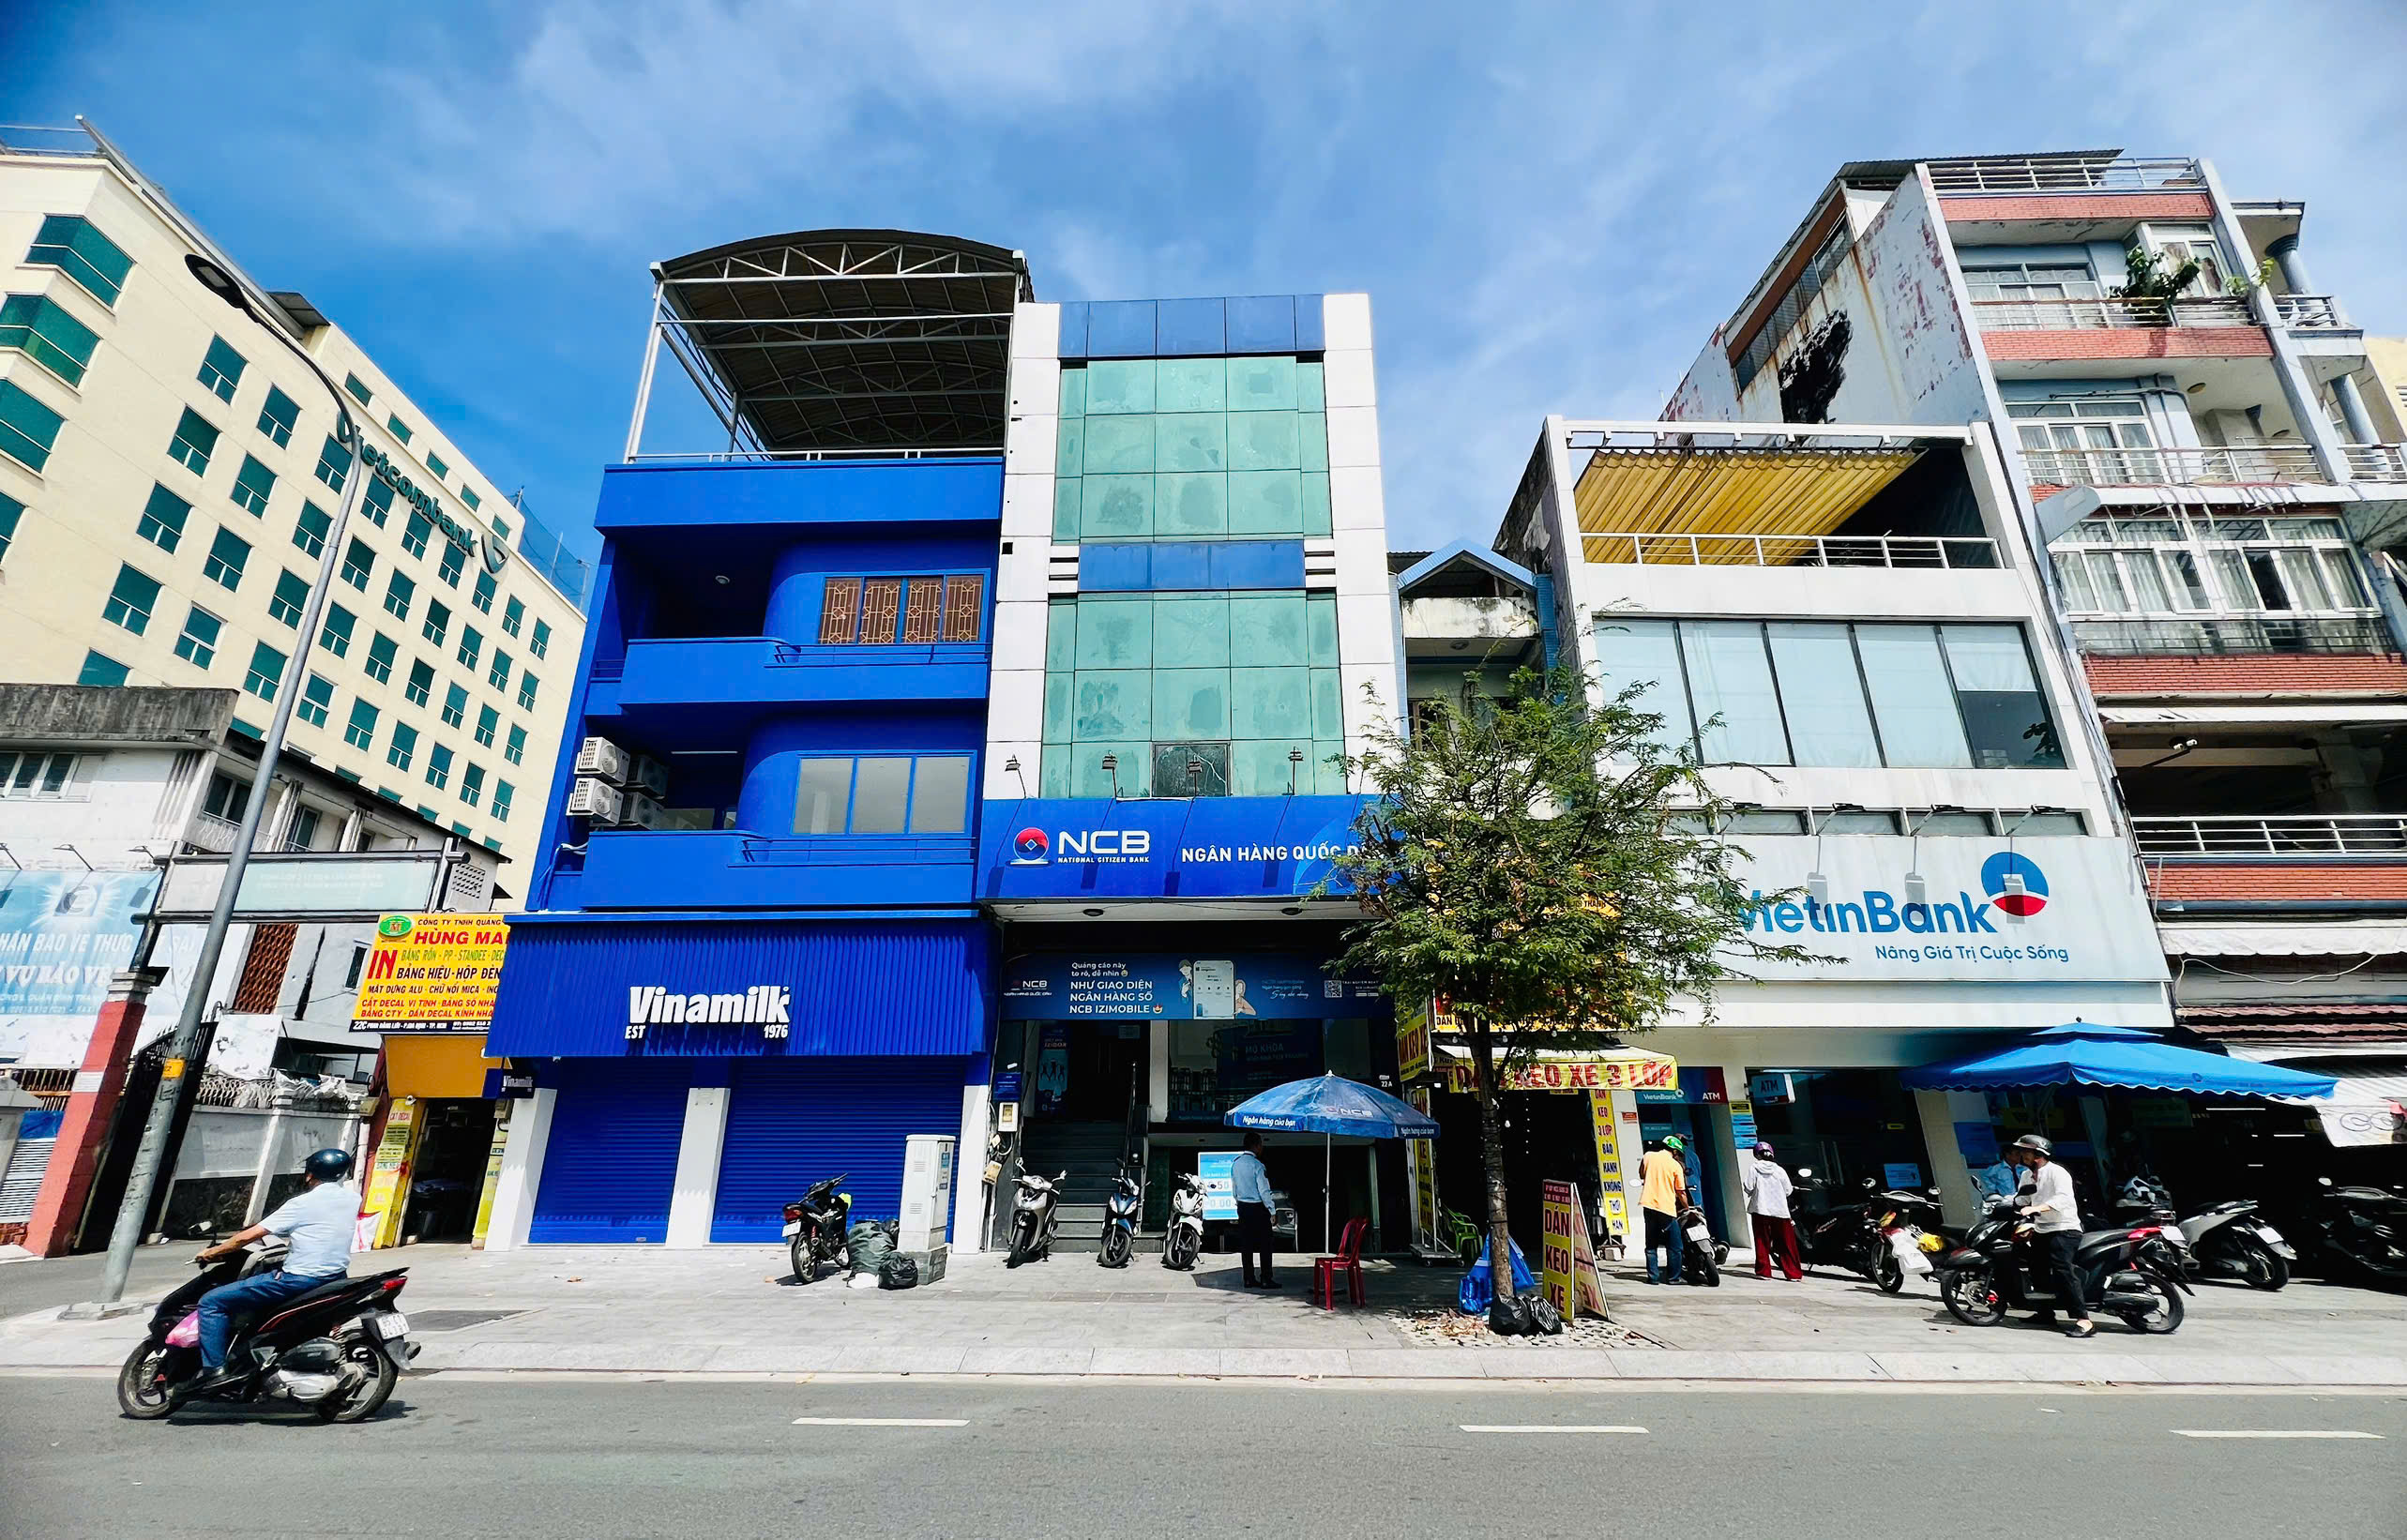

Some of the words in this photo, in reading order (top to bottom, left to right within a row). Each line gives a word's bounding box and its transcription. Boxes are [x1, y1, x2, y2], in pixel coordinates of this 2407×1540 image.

[1058, 830, 1151, 854] NCB
[1182, 844, 1232, 862] NGÂN
[1237, 842, 1288, 861] HÀNG
[417, 917, 438, 926] CÔNG
[414, 928, 469, 945] HÙNG
[443, 949, 452, 960] PP
[457, 949, 487, 961] STANDEE
[1876, 945, 1920, 962] Nâng
[1924, 945, 1953, 960] Giá
[1957, 946, 1976, 963] Trị
[1980, 945, 2023, 964] Cuộc
[2028, 944, 2069, 962] Sống
[367, 949, 398, 979] IN
[1071, 961, 1097, 970] Quảng
[396, 963, 425, 979] BẢNG
[427, 965, 451, 982] HIỆU
[455, 965, 477, 982] HỘP
[408, 985, 423, 994] ALU
[462, 985, 479, 994] MICA
[1070, 979, 1096, 990] NHƯ
[1097, 980, 1124, 989] GIAO
[1127, 979, 1153, 991] DIỆN
[1069, 991, 1100, 1002] NGÂN
[1103, 991, 1136, 1002] HÀNG
[1138, 991, 1154, 1002] SỐ
[629, 986, 790, 1024] Vinamilk
[1069, 1004, 1093, 1014] NCB
[1095, 1004, 1150, 1014] IZIMOBILE
[353, 1020, 367, 1030] 22C
[764, 1024, 788, 1038] 1976
[626, 1025, 645, 1039] EST
[1567, 1064, 1599, 1088] XE
[1606, 1064, 1622, 1087] 3
[1628, 1059, 1673, 1088] LỚP
[503, 1076, 533, 1087] Vinamilk
[1760, 1080, 1779, 1093] ATM
[1703, 1092, 1720, 1100] ATM
[1340, 1108, 1373, 1119] NCB
[1242, 1115, 1259, 1125] Ngân
[1259, 1117, 1274, 1126] hàng
[1544, 1205, 1569, 1238] DÁN
[1545, 1244, 1569, 1276] KEO
[1549, 1281, 1565, 1313] XE
